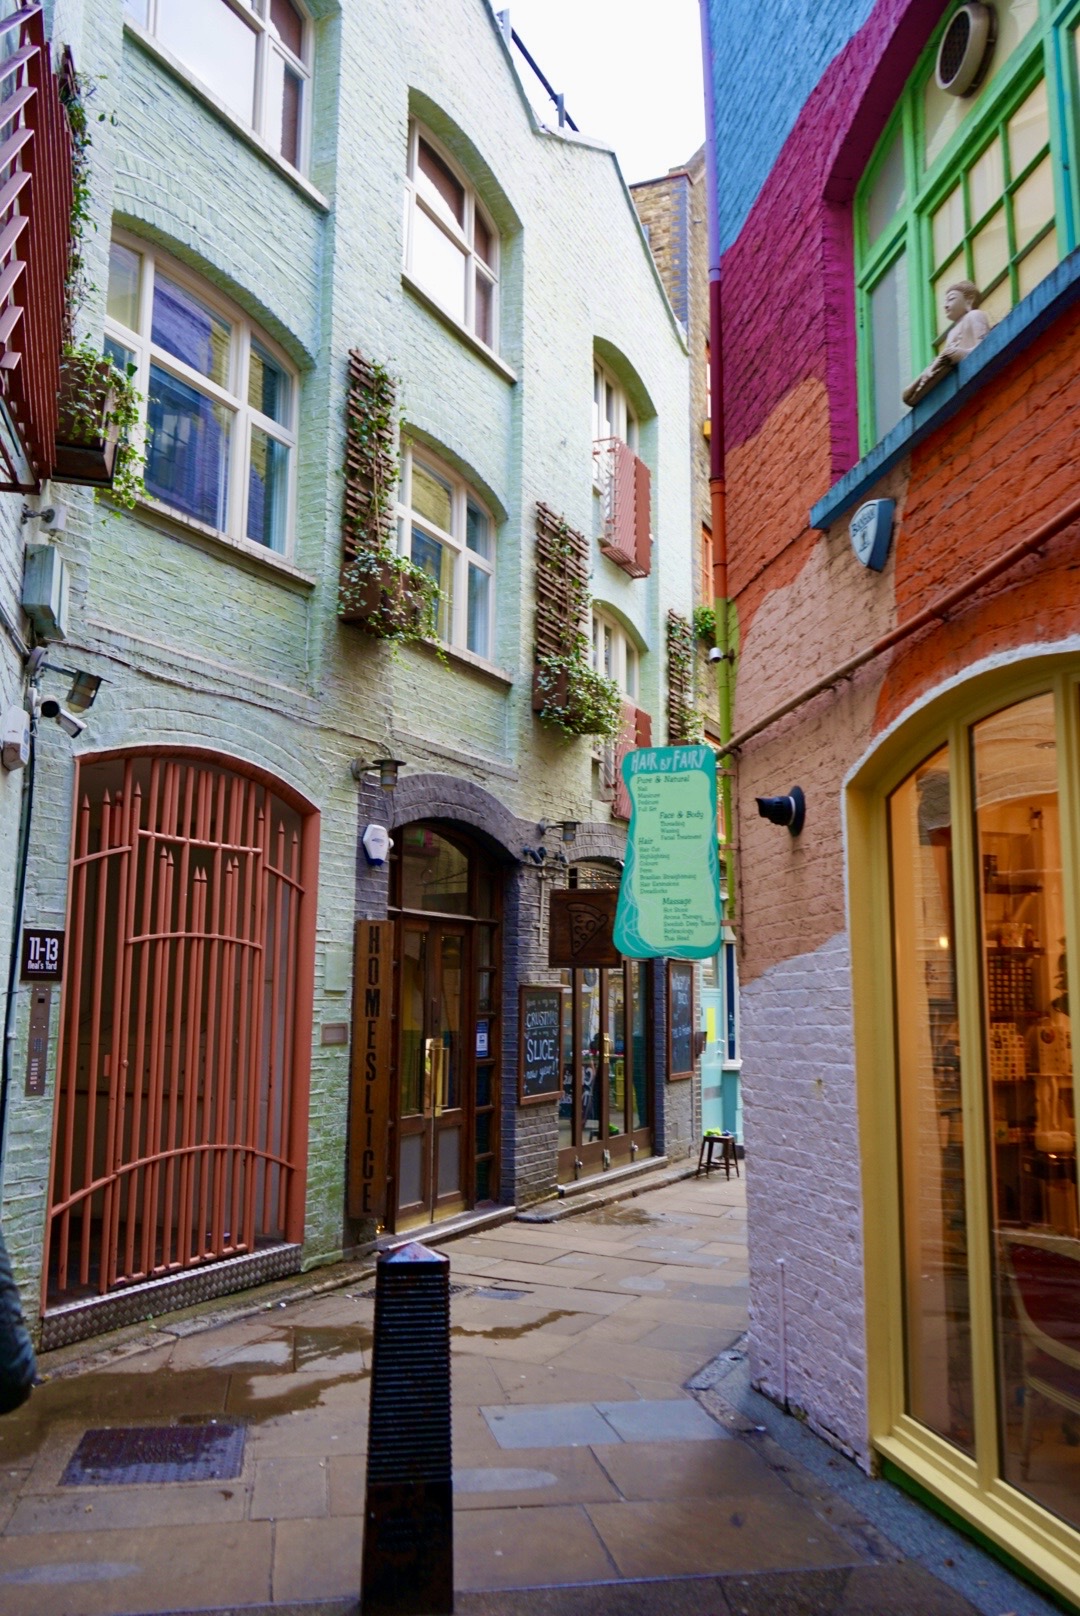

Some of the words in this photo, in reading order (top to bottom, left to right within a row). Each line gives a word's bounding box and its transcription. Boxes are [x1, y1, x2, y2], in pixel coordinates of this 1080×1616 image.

[631, 751, 658, 773] HAIR
[673, 749, 706, 771] FAIRY
[637, 776, 652, 784] Pure
[655, 775, 661, 783] &
[664, 775, 690, 783] Natural
[660, 811, 675, 819] Face
[677, 811, 684, 819] &
[686, 810, 704, 820] Body
[638, 837, 653, 845] Hair
[662, 897, 692, 906] Massage
[682, 913, 702, 921] Therapy
[686, 920, 699, 928] Deep
[29, 936, 59, 961] 11-13
[27, 960, 44, 970] Neal's
[45, 960, 58, 970] Yard
[526, 1038, 555, 1063] SLICE
